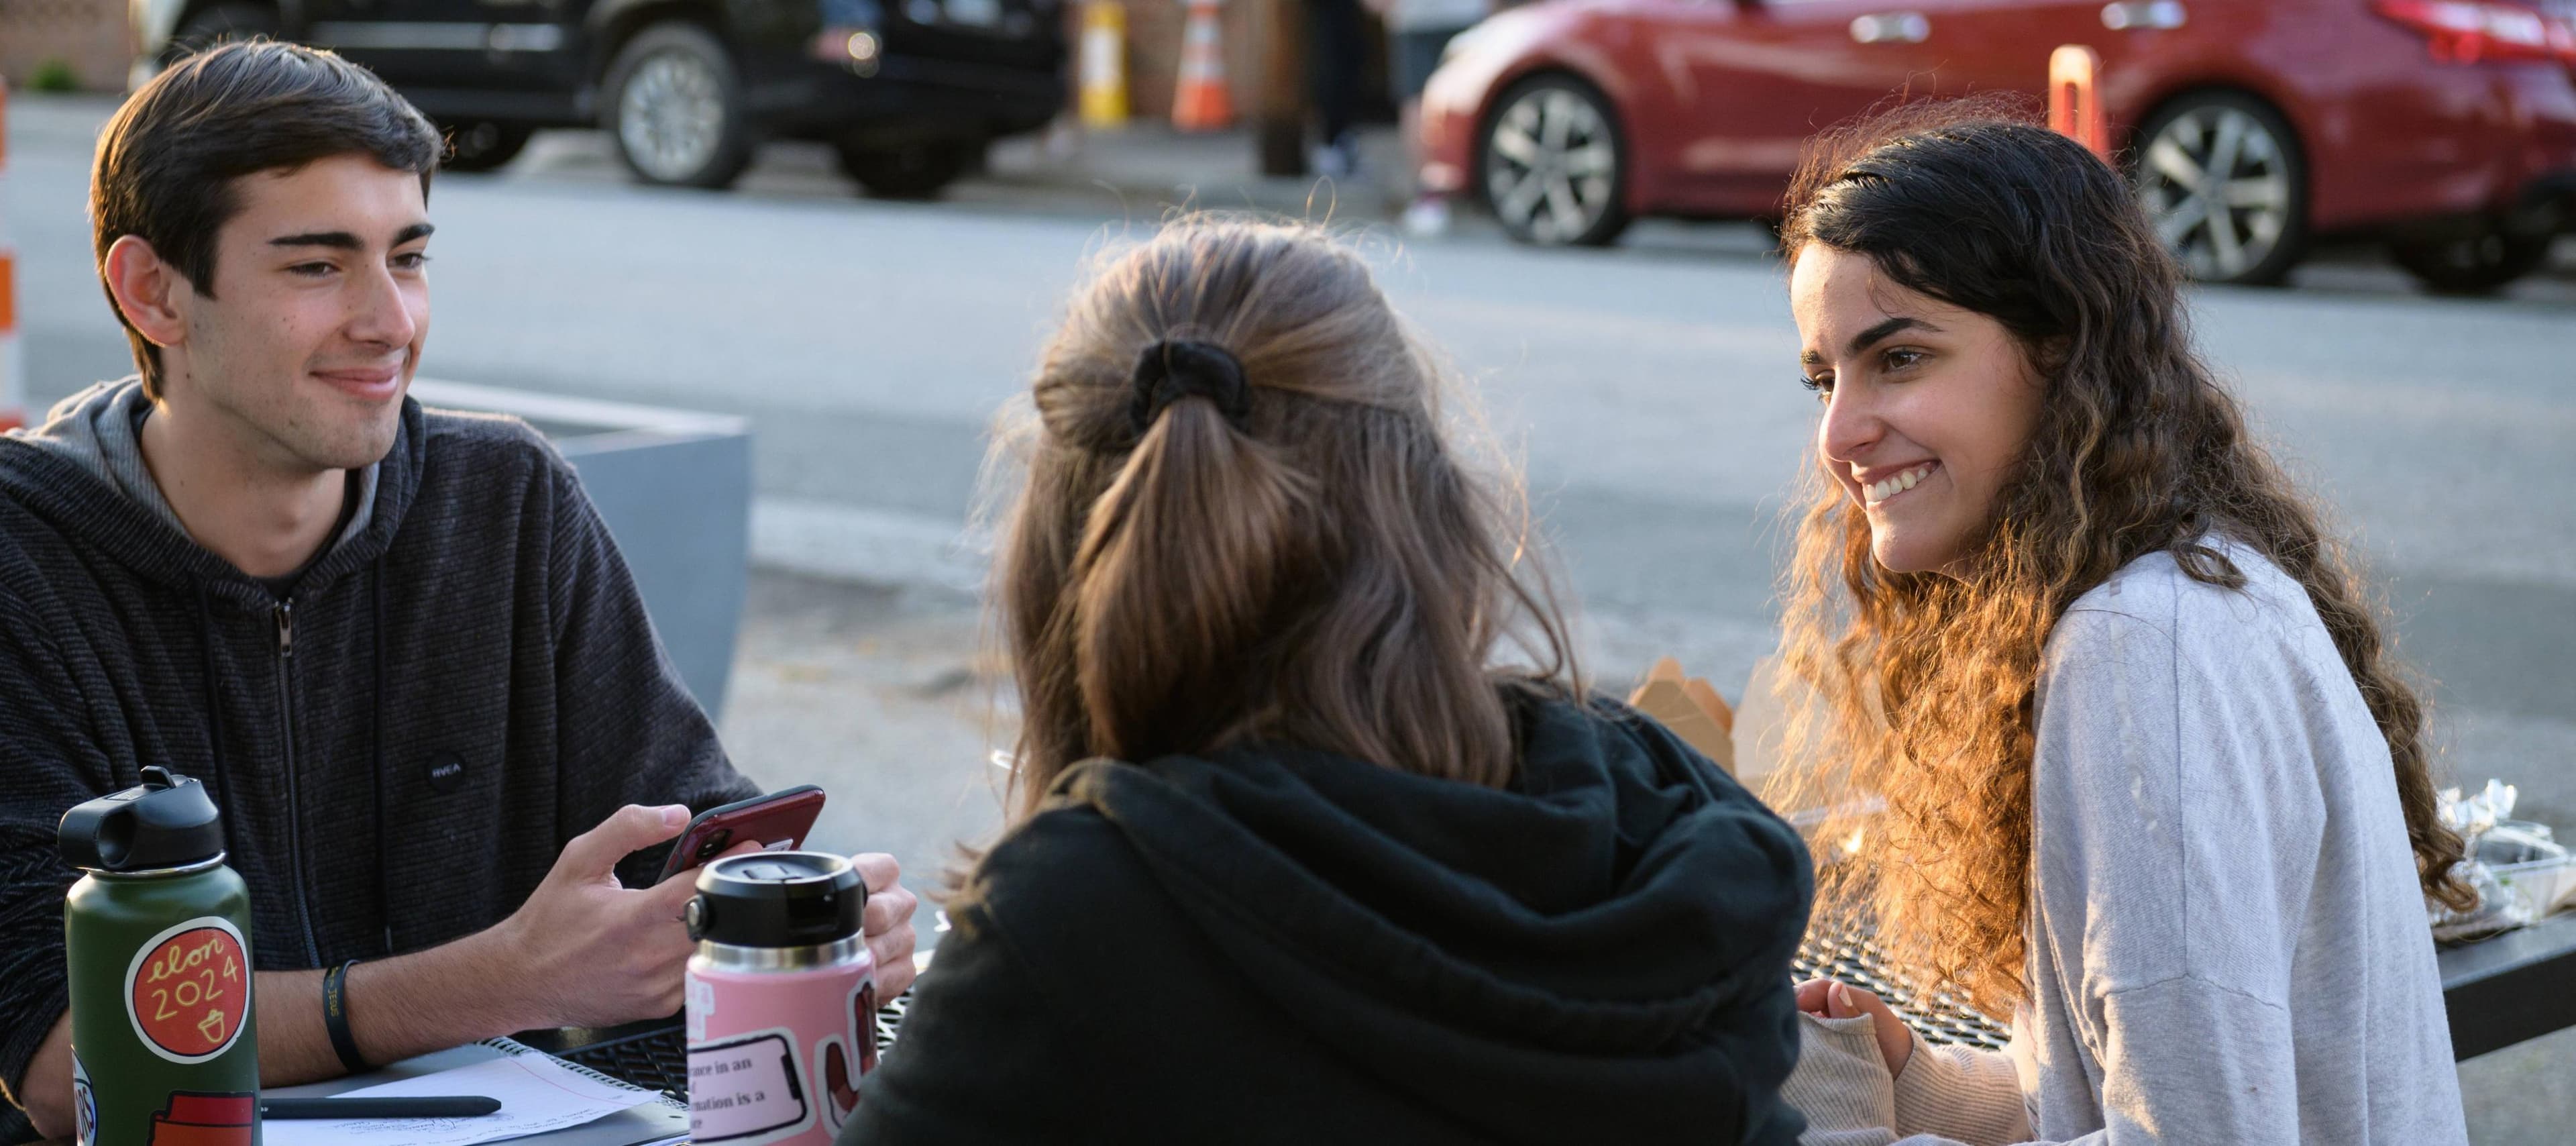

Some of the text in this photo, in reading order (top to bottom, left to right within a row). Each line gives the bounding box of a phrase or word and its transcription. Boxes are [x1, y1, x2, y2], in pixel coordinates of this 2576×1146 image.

[147, 939, 224, 984] elon
[151, 955, 238, 1021] 2024
[714, 1060, 729, 1074] in
[732, 1057, 752, 1072] an
[736, 1092, 751, 1106] is
[755, 1090, 765, 1102] a
